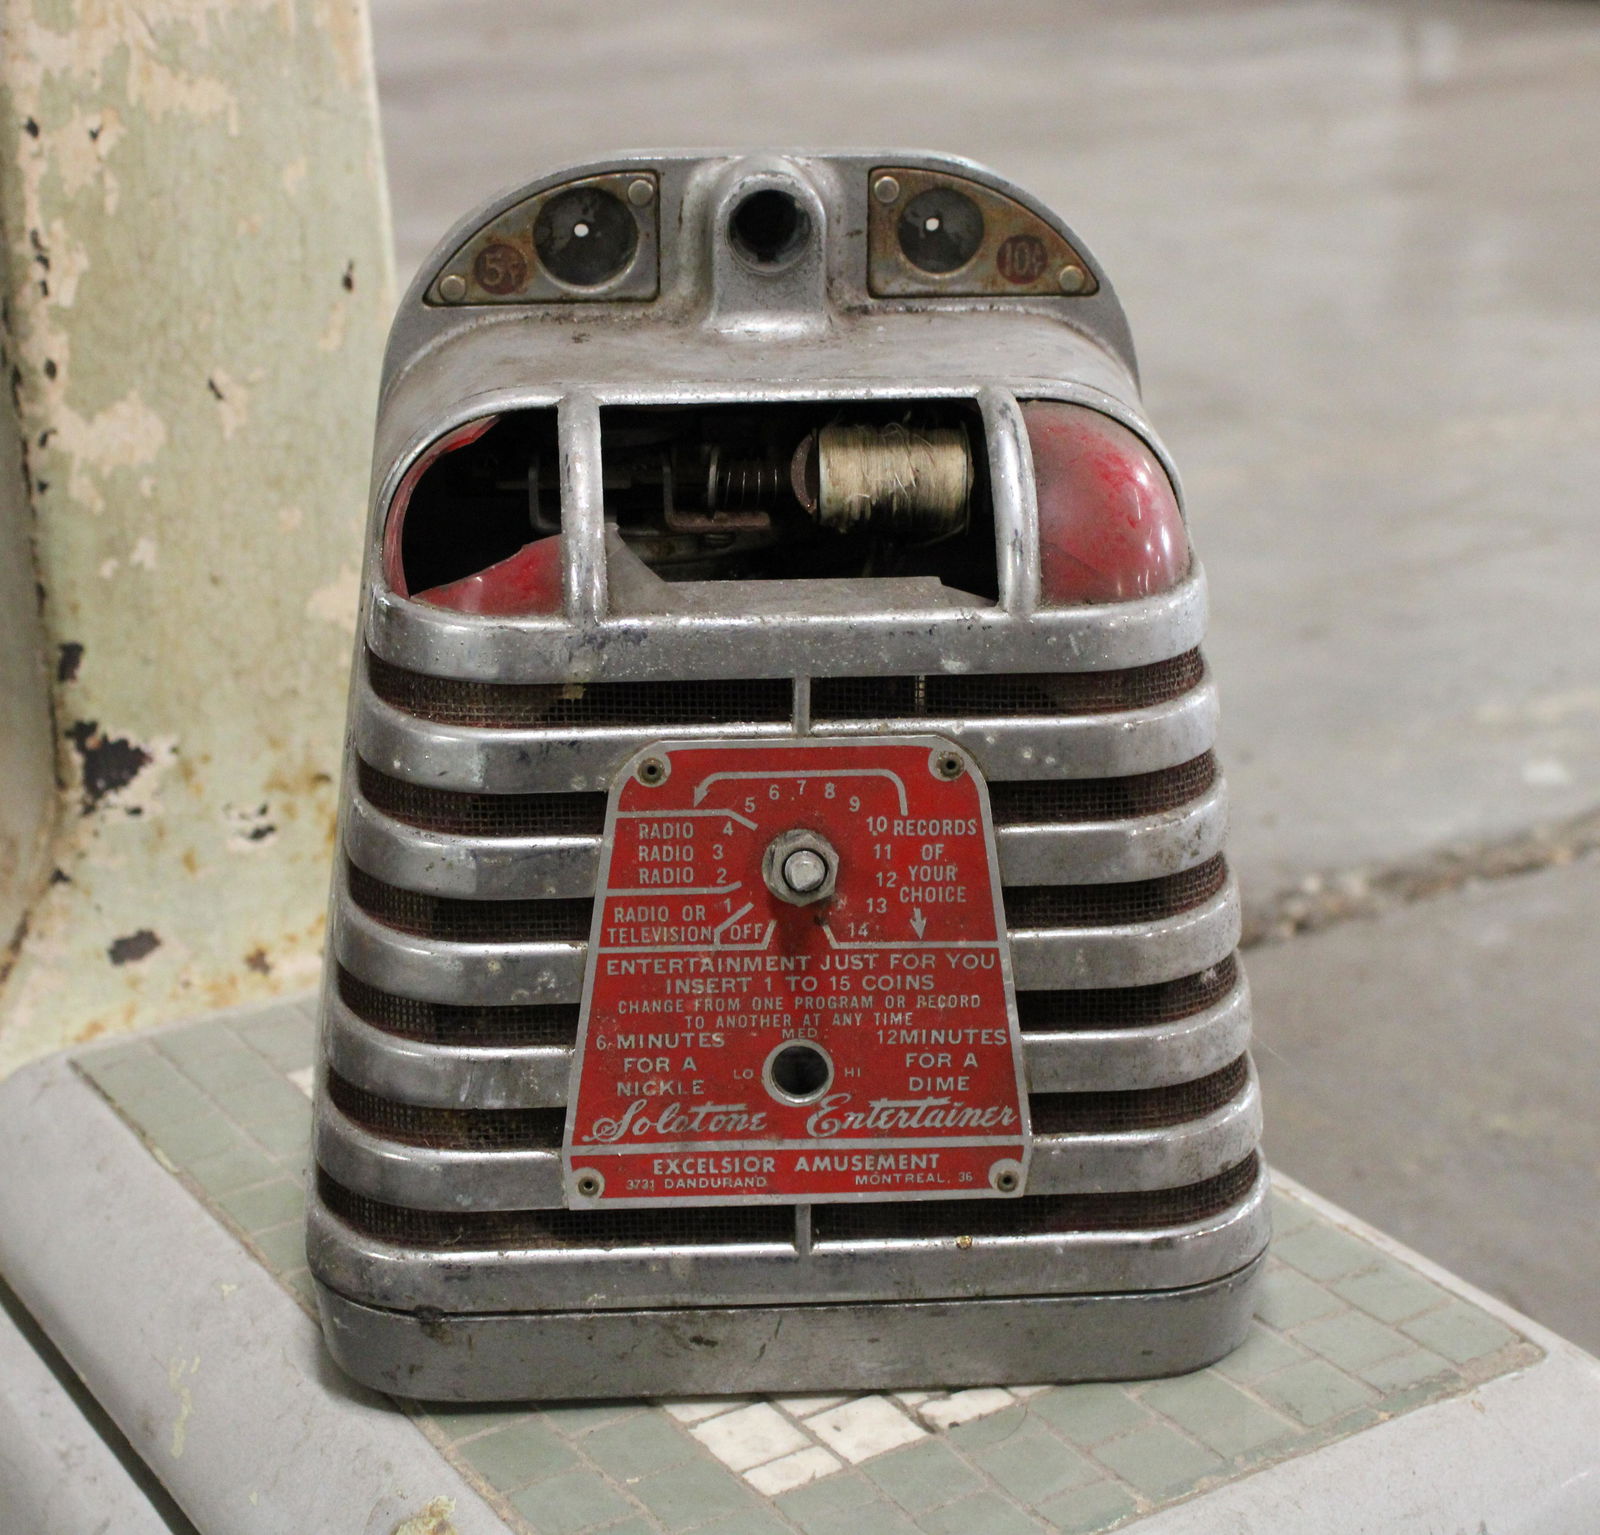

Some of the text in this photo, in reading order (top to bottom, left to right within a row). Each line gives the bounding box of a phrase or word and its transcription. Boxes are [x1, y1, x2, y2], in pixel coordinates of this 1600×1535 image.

[769, 784, 780, 800] 6
[797, 780, 806, 795] 7
[825, 782, 835, 799] 8
[745, 797, 755, 813] 5
[849, 796, 860, 812] 9
[639, 821, 733, 840] RADIO 4
[866, 816, 887, 833] 10
[894, 819, 977, 836] RECORDS
[639, 844, 723, 862] RADIO 3
[873, 844, 892, 859] 11
[922, 844, 944, 861] OF
[639, 868, 727, 884] RADIO 2
[876, 872, 897, 888] 12
[908, 865, 956, 881] YOUR
[900, 886, 966, 903] CHOICE
[614, 898, 731, 923] RADIO OR 1
[866, 897, 887, 913] 13
[608, 926, 712, 944] TELEVISION
[730, 923, 763, 940] OFF
[848, 922, 869, 937] 14
[607, 953, 995, 975] ENTERTAINMENT JUST FOR YOU
[666, 974, 935, 994] INSERT 1 TO 15 COINS
[618, 994, 981, 1014] CHANGE FROM ONE PROGRAM OR RECORD
[685, 1012, 913, 1029] TO ANOTHER AT ANY TIME
[617, 1033, 725, 1050] MINUTES
[782, 1028, 817, 1039] MED
[624, 1056, 697, 1073] FOR A
[906, 1053, 978, 1068] FOR A
[734, 1069, 753, 1080] LO
[845, 1067, 860, 1078] HI
[617, 1080, 704, 1097] NICKLE
[909, 1076, 970, 1091] DIME
[806, 1093, 1018, 1138] Entertainer
[654, 1153, 940, 1175] EXCELSIOR AMUSEMENT
[665, 1176, 768, 1188] DANDURAND
[959, 1172, 973, 1182] 36
